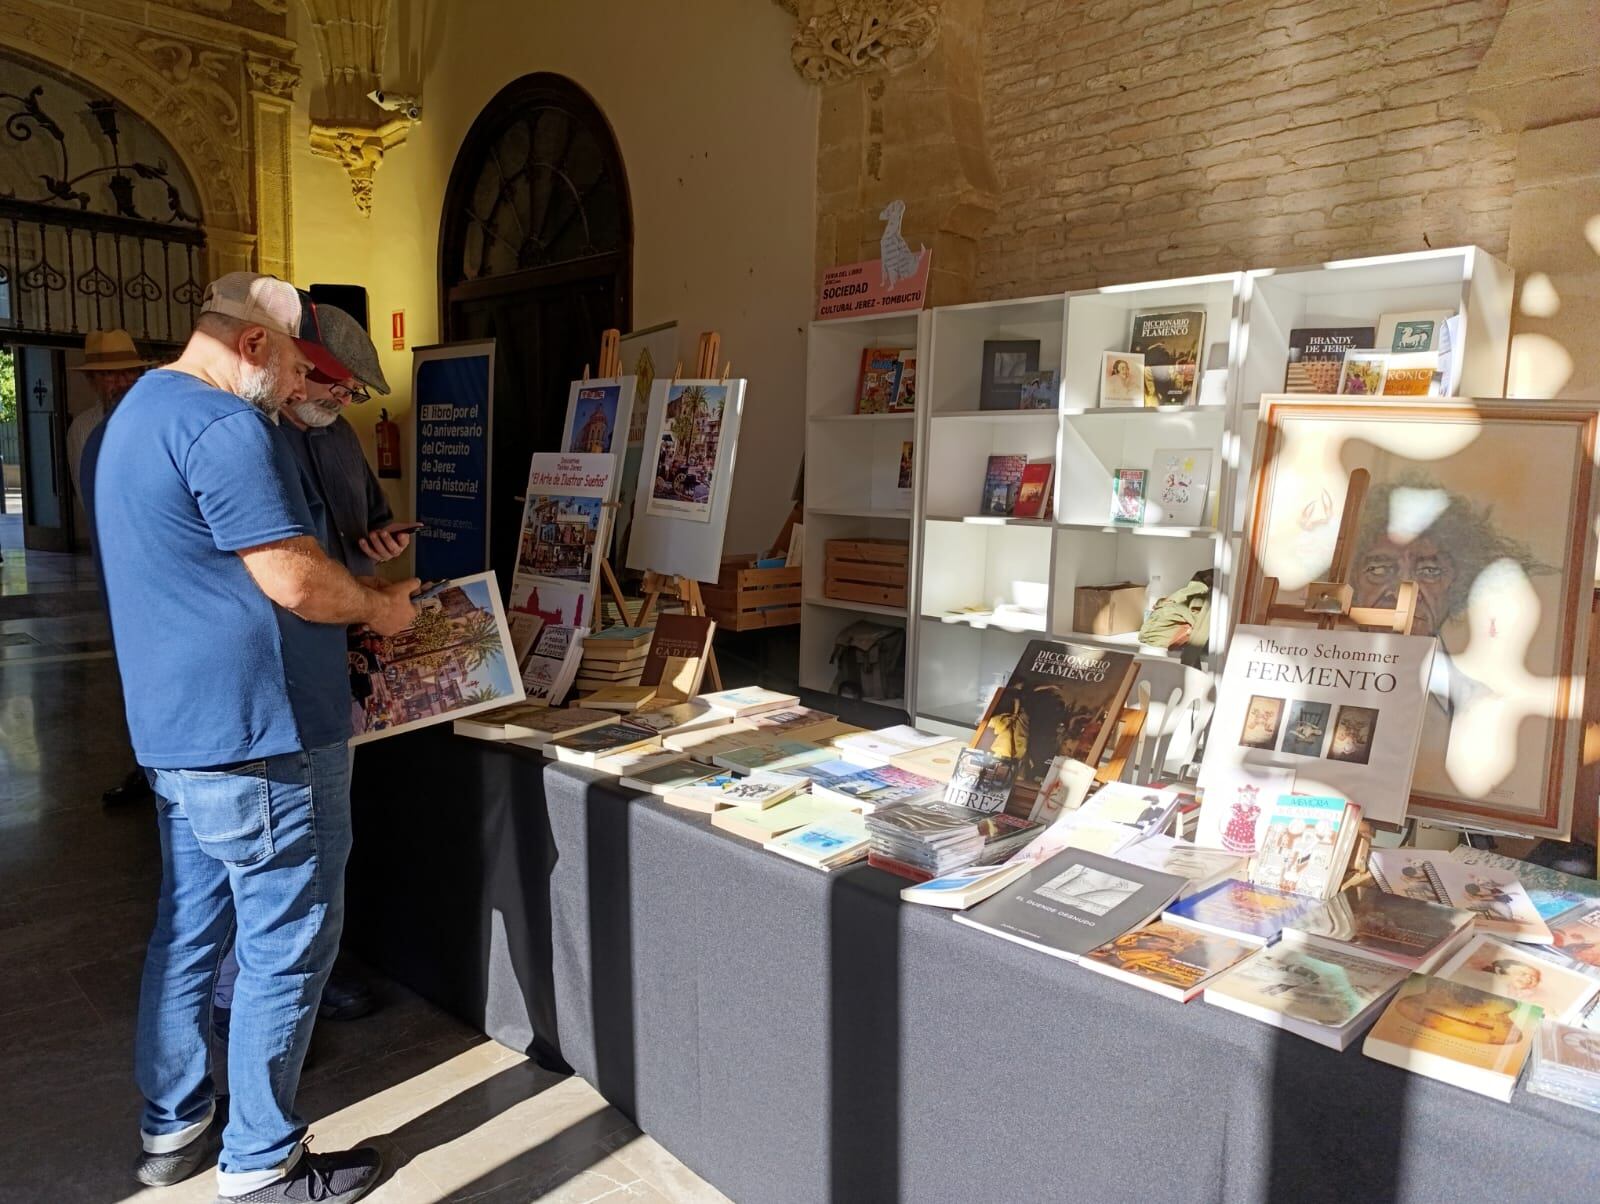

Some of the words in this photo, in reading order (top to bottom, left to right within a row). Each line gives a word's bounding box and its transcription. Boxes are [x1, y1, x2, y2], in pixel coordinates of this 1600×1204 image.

[823, 282, 868, 300] SOCIEDAD
[820, 302, 853, 315] CULTURAL
[855, 299, 876, 310] JEREZ
[882, 290, 921, 306] TOMBUCTÚ
[1143, 319, 1189, 328] DICCIONARIO
[1142, 328, 1188, 337] FLAMENCO
[1310, 336, 1354, 345] BRANDY
[1305, 345, 1319, 353] DE
[1322, 345, 1356, 353] JEREZ
[422, 406, 429, 418] El
[432, 406, 451, 418] libro
[453, 408, 468, 421] por
[470, 404, 479, 418] el
[422, 424, 433, 437] 40
[434, 423, 482, 437] aniversario
[422, 442, 433, 455] del
[435, 442, 470, 455] Circuito
[422, 460, 431, 472] de
[433, 460, 456, 473] Jerez
[442, 478, 478, 493] historia!
[1038, 650, 1110, 670] DICCIONARIO
[1254, 639, 1308, 657] Alberto
[1314, 643, 1400, 665] Schommer
[1031, 661, 1105, 682] FLAMENCO
[1246, 661, 1397, 693] FERMENTO
[948, 788, 1004, 812] JEREZ
